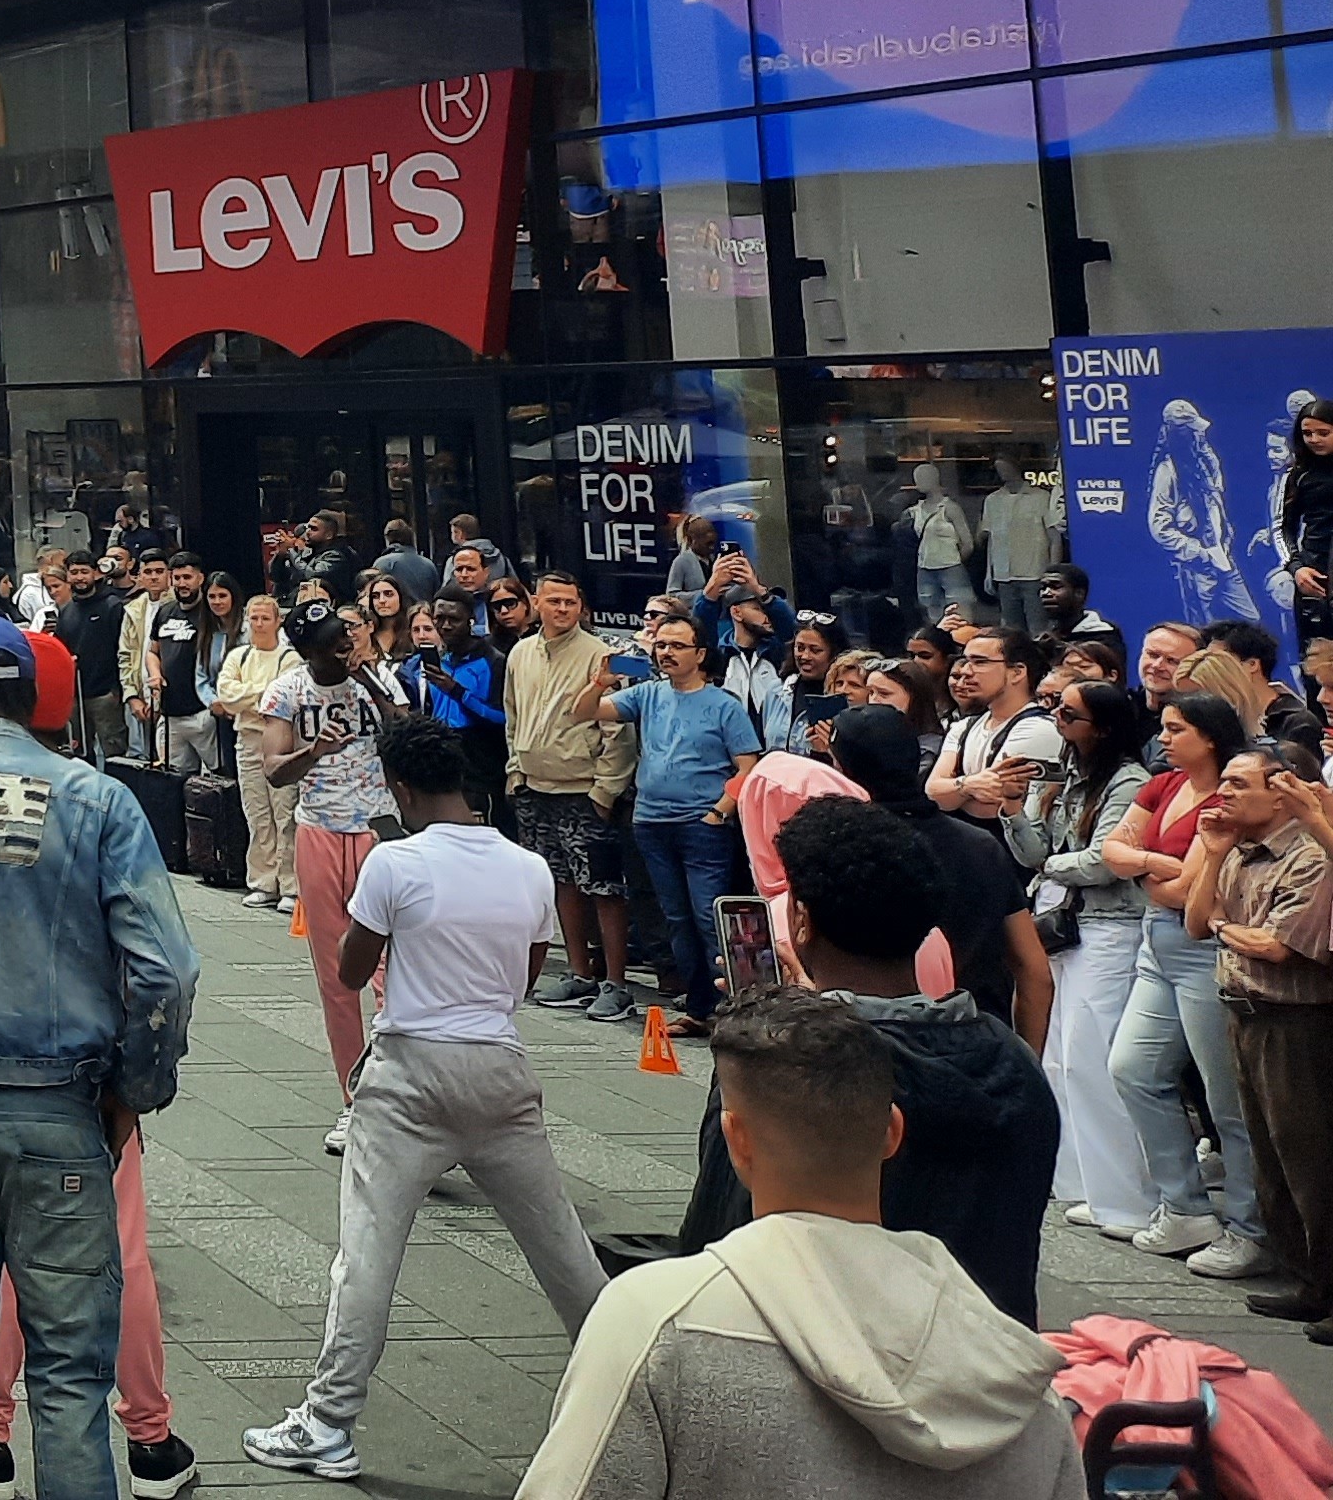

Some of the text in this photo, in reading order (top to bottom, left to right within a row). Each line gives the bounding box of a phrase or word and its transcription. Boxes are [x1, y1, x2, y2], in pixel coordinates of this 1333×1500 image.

[1061, 347, 1161, 378] DENIM
[1065, 383, 1129, 412] FOR
[576, 424, 694, 465] DENIM
[1067, 416, 1132, 446] LIFE
[579, 471, 656, 513] FOR
[583, 522, 658, 564] LIFE
[296, 697, 381, 741] USA
